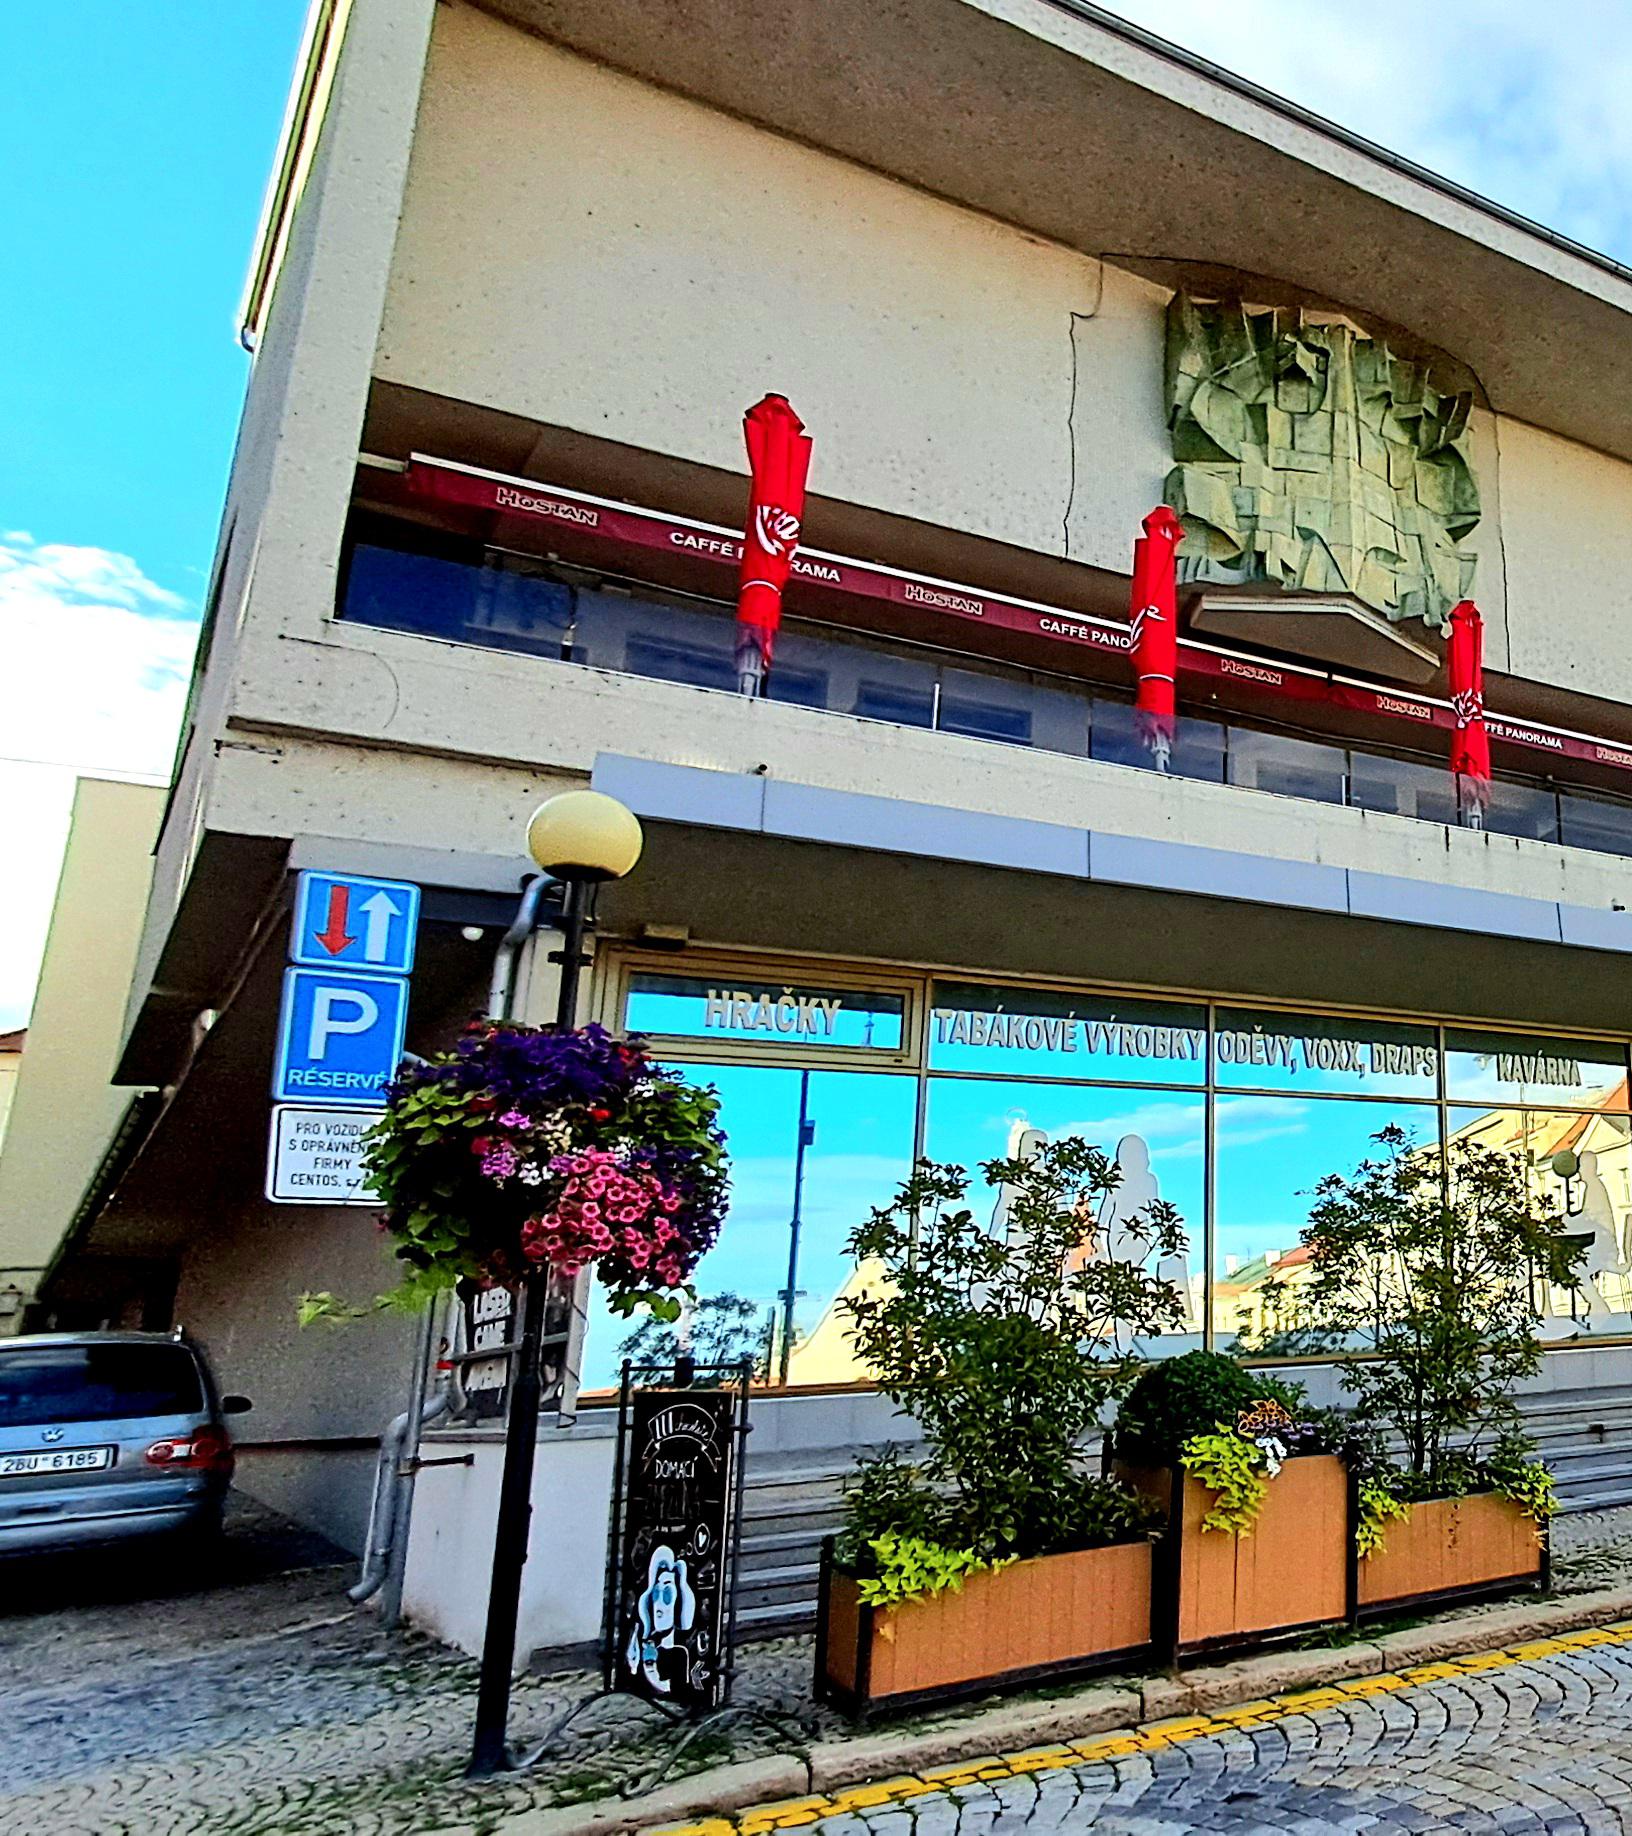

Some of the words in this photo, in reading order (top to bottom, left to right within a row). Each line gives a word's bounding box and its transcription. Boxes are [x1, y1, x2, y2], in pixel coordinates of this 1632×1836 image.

[497, 487, 598, 526] HOSTAN
[669, 532, 733, 557] CAFFÉ
[905, 584, 983, 615] HOSTAN
[1039, 618, 1089, 640] CAFFÉ
[1505, 728, 1563, 749] PANORAMA
[308, 986, 379, 1061] P
[704, 987, 842, 1036] HRAČKY
[934, 1005, 1078, 1052] TABÁKOVÉ
[1084, 1013, 1206, 1061] VÝROBKY
[1217, 1025, 1298, 1074] ODĚVY,
[1302, 1037, 1367, 1078] VOXX,
[1370, 1042, 1440, 1077] DRAPS
[1496, 1049, 1583, 1087] KAVÁRNA
[288, 1138, 297, 1151] S
[296, 1122, 321, 1135] PRO
[325, 1123, 365, 1136] VOZIDL
[313, 1157, 352, 1170] FIRMY
